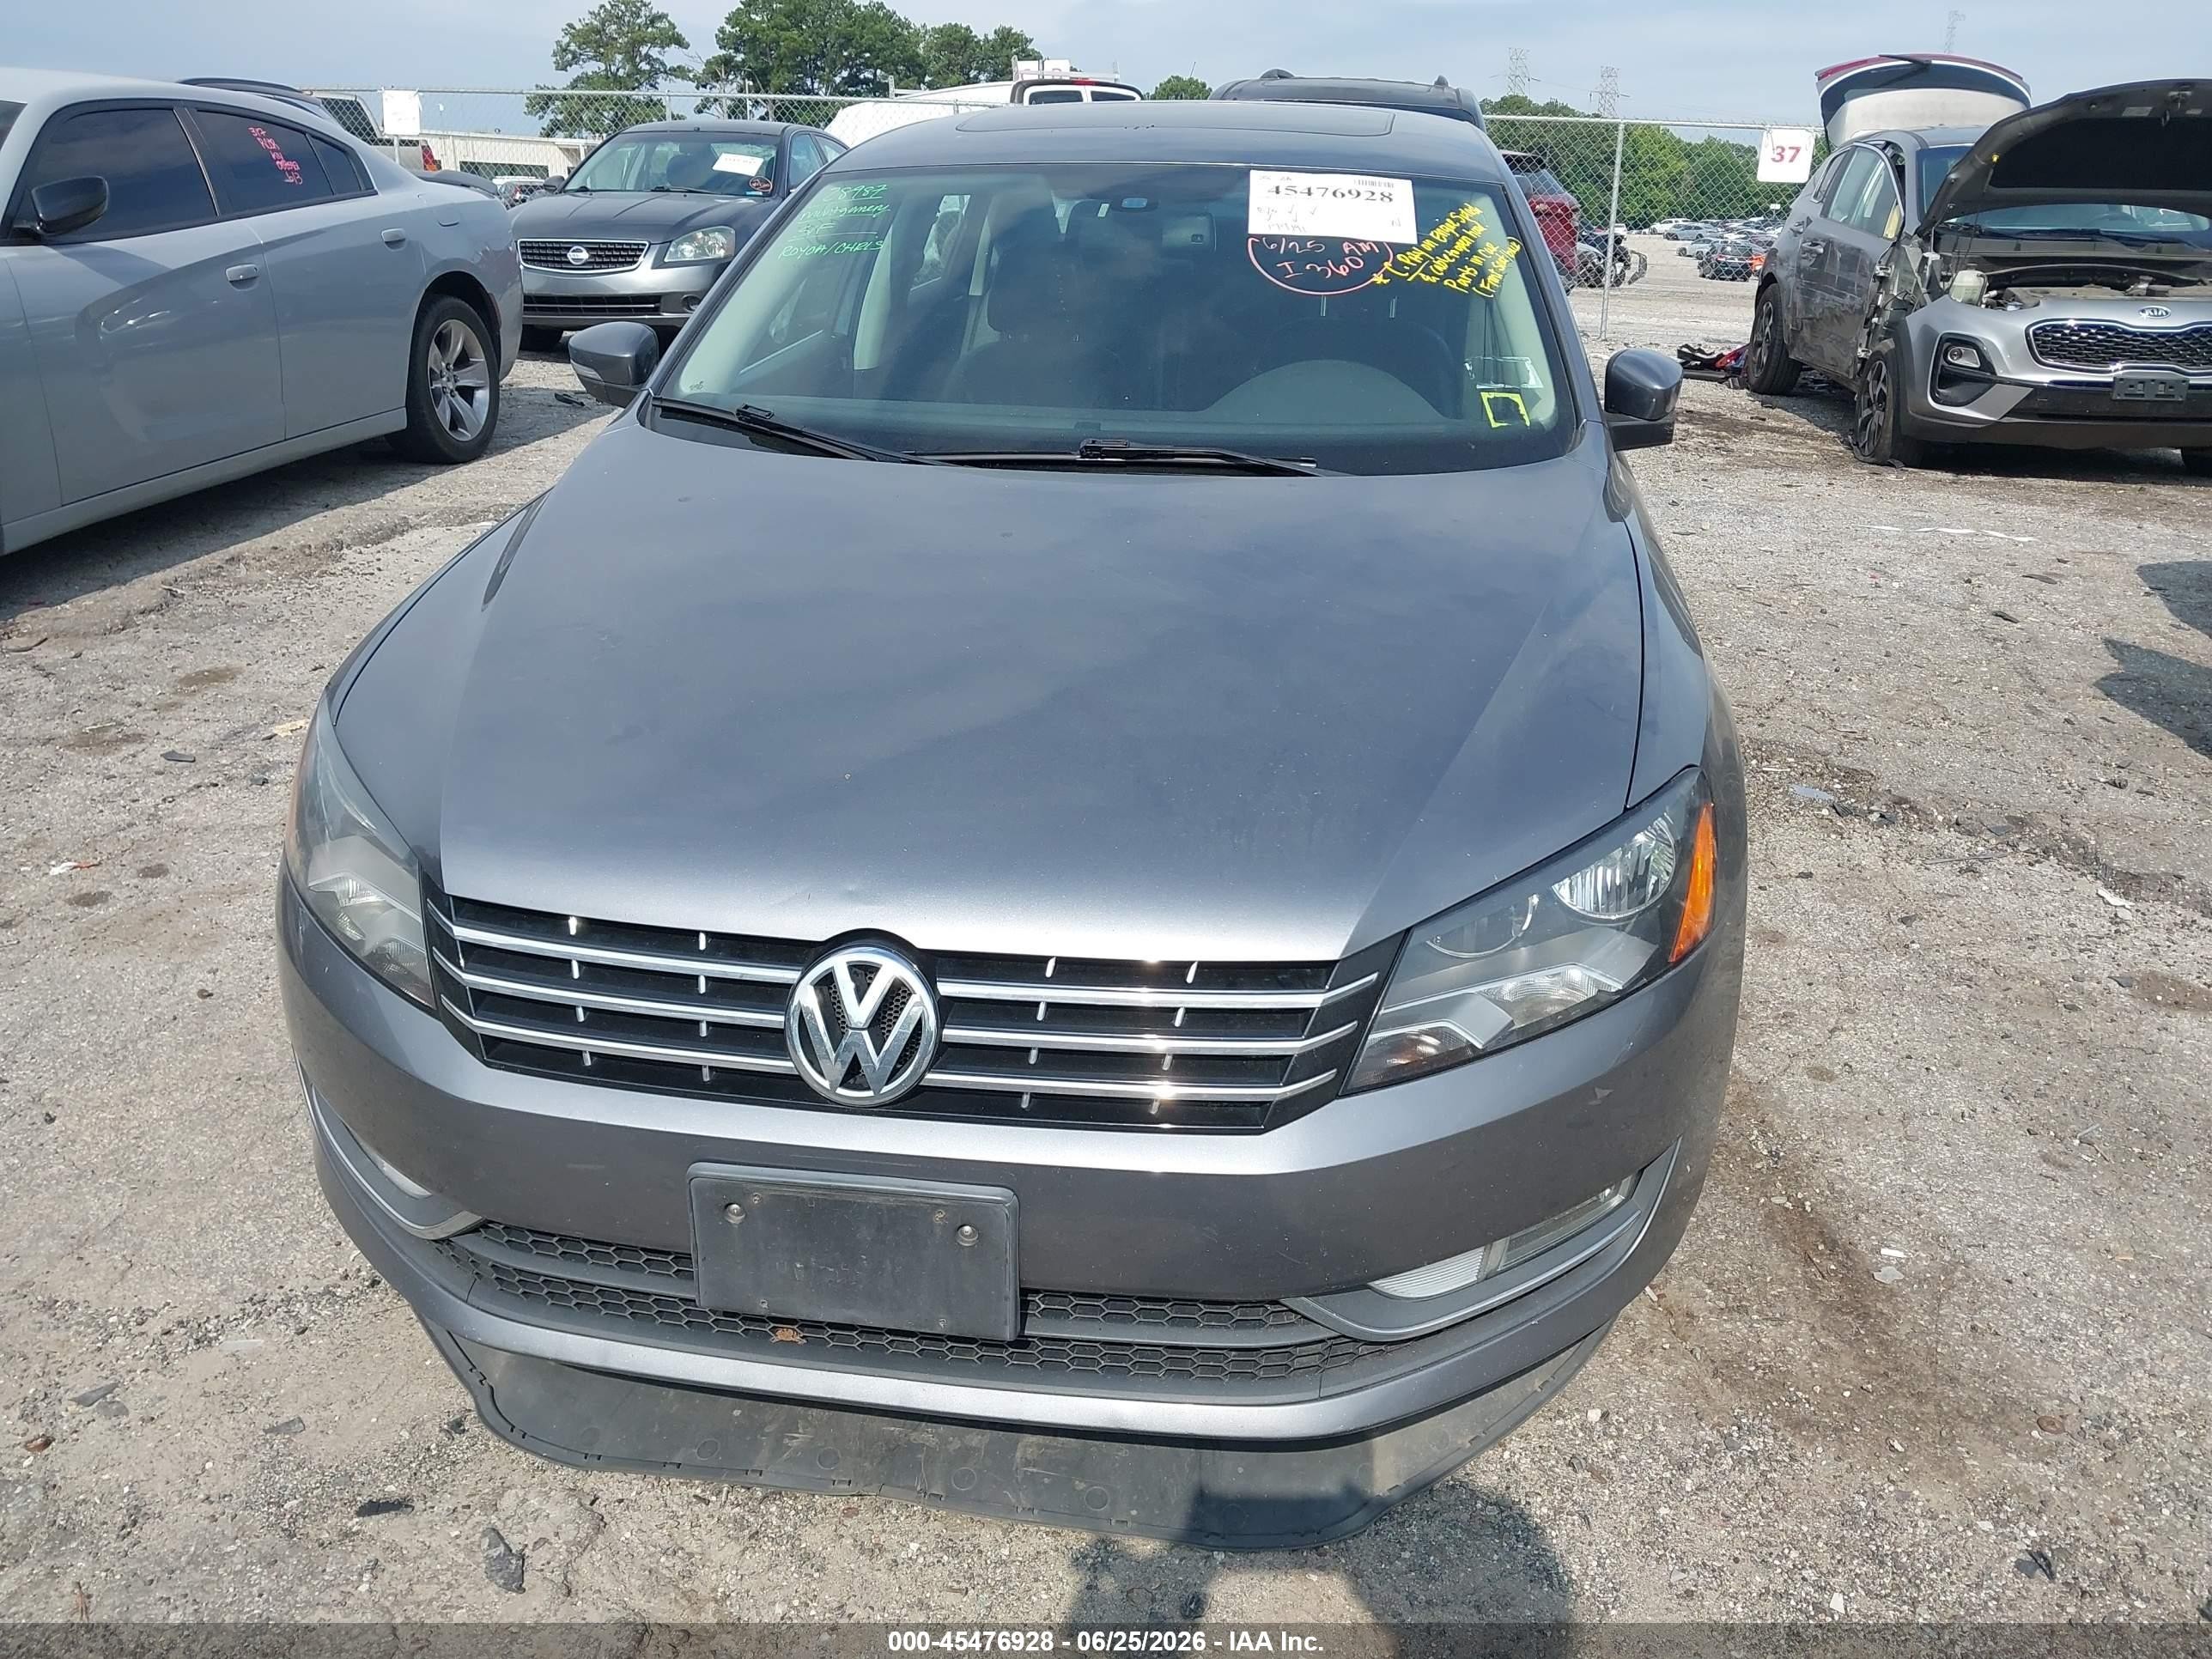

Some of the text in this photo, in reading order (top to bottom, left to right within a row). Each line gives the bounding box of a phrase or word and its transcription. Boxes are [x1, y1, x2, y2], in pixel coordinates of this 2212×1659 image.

[1771, 146, 1801, 163] 37
[1267, 184, 1395, 204] 45476928
[1262, 237, 1380, 256] 6/25 AM
